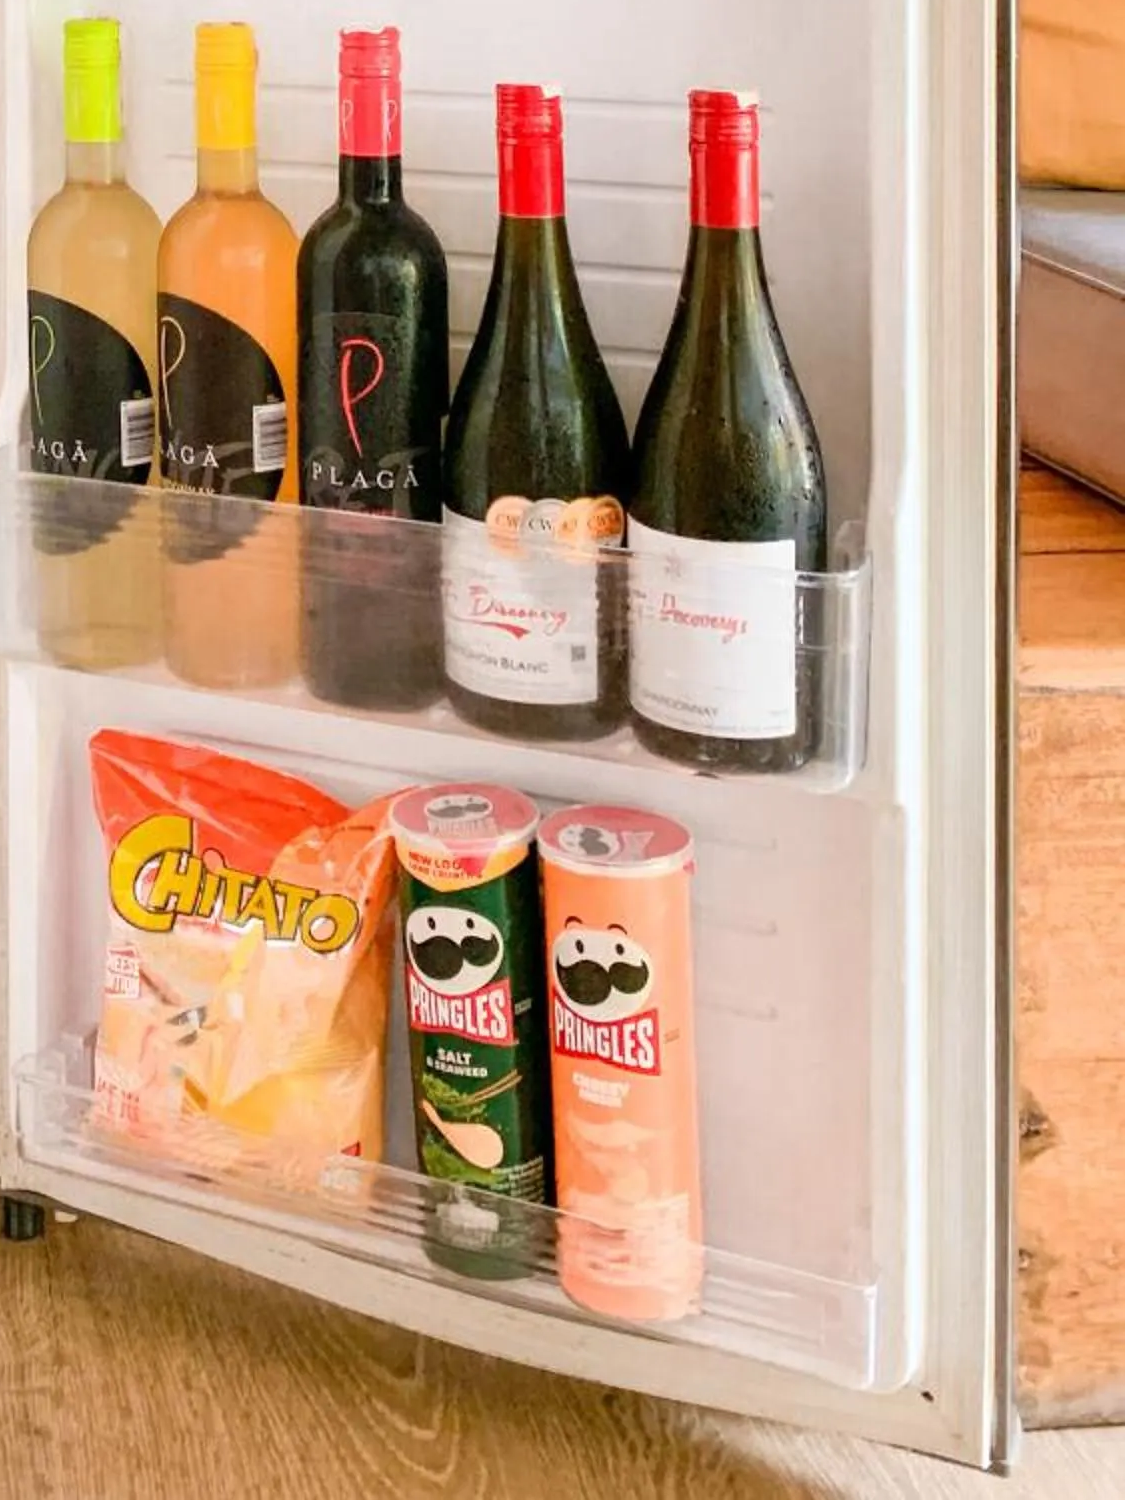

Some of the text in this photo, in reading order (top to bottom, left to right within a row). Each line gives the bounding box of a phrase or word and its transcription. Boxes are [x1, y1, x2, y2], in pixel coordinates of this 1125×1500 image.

[338, 335, 385, 458] P
[410, 976, 508, 1039] PRINGLES
[554, 999, 655, 1069] PRINGLES
[437, 1047, 472, 1066] SALT
